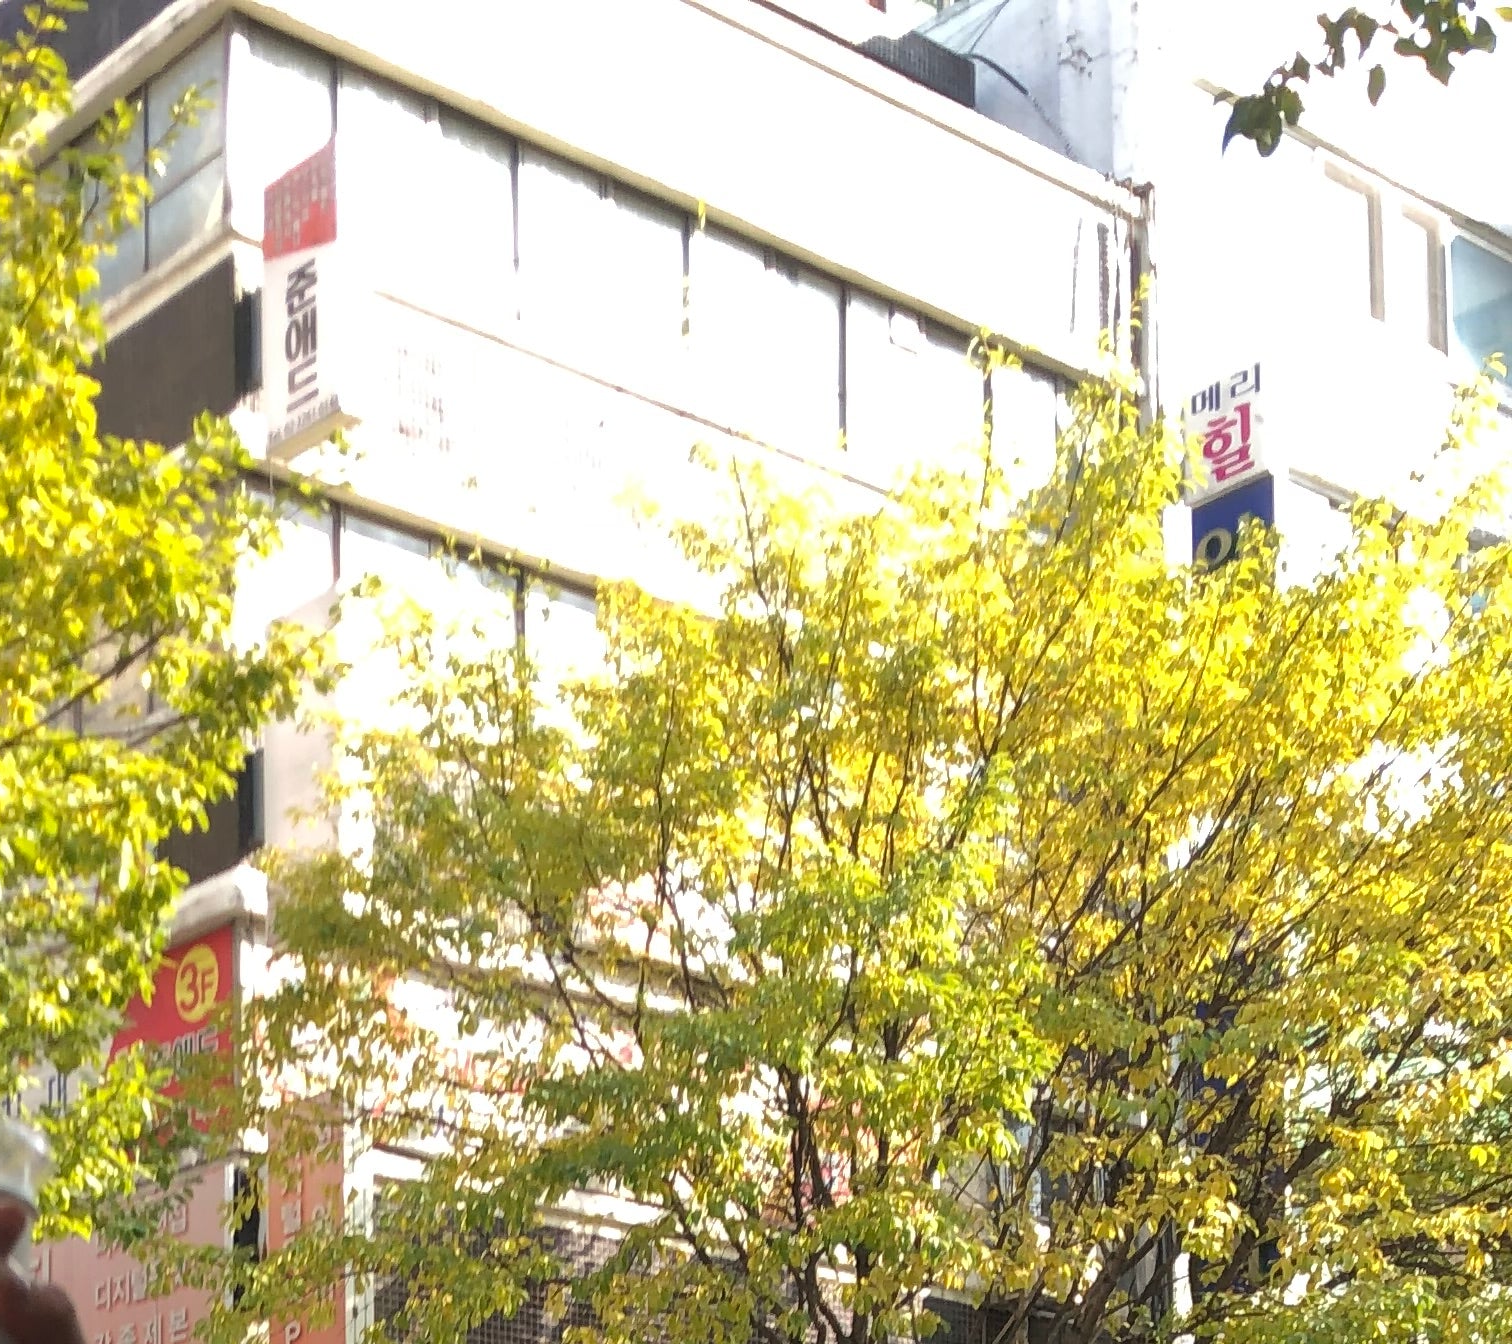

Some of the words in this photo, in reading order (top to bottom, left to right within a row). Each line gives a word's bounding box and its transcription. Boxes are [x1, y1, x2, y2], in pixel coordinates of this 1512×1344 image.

[1191, 362, 1260, 415] 메리
[1203, 402, 1255, 483] 힐
[180, 958, 215, 1010] 3F
